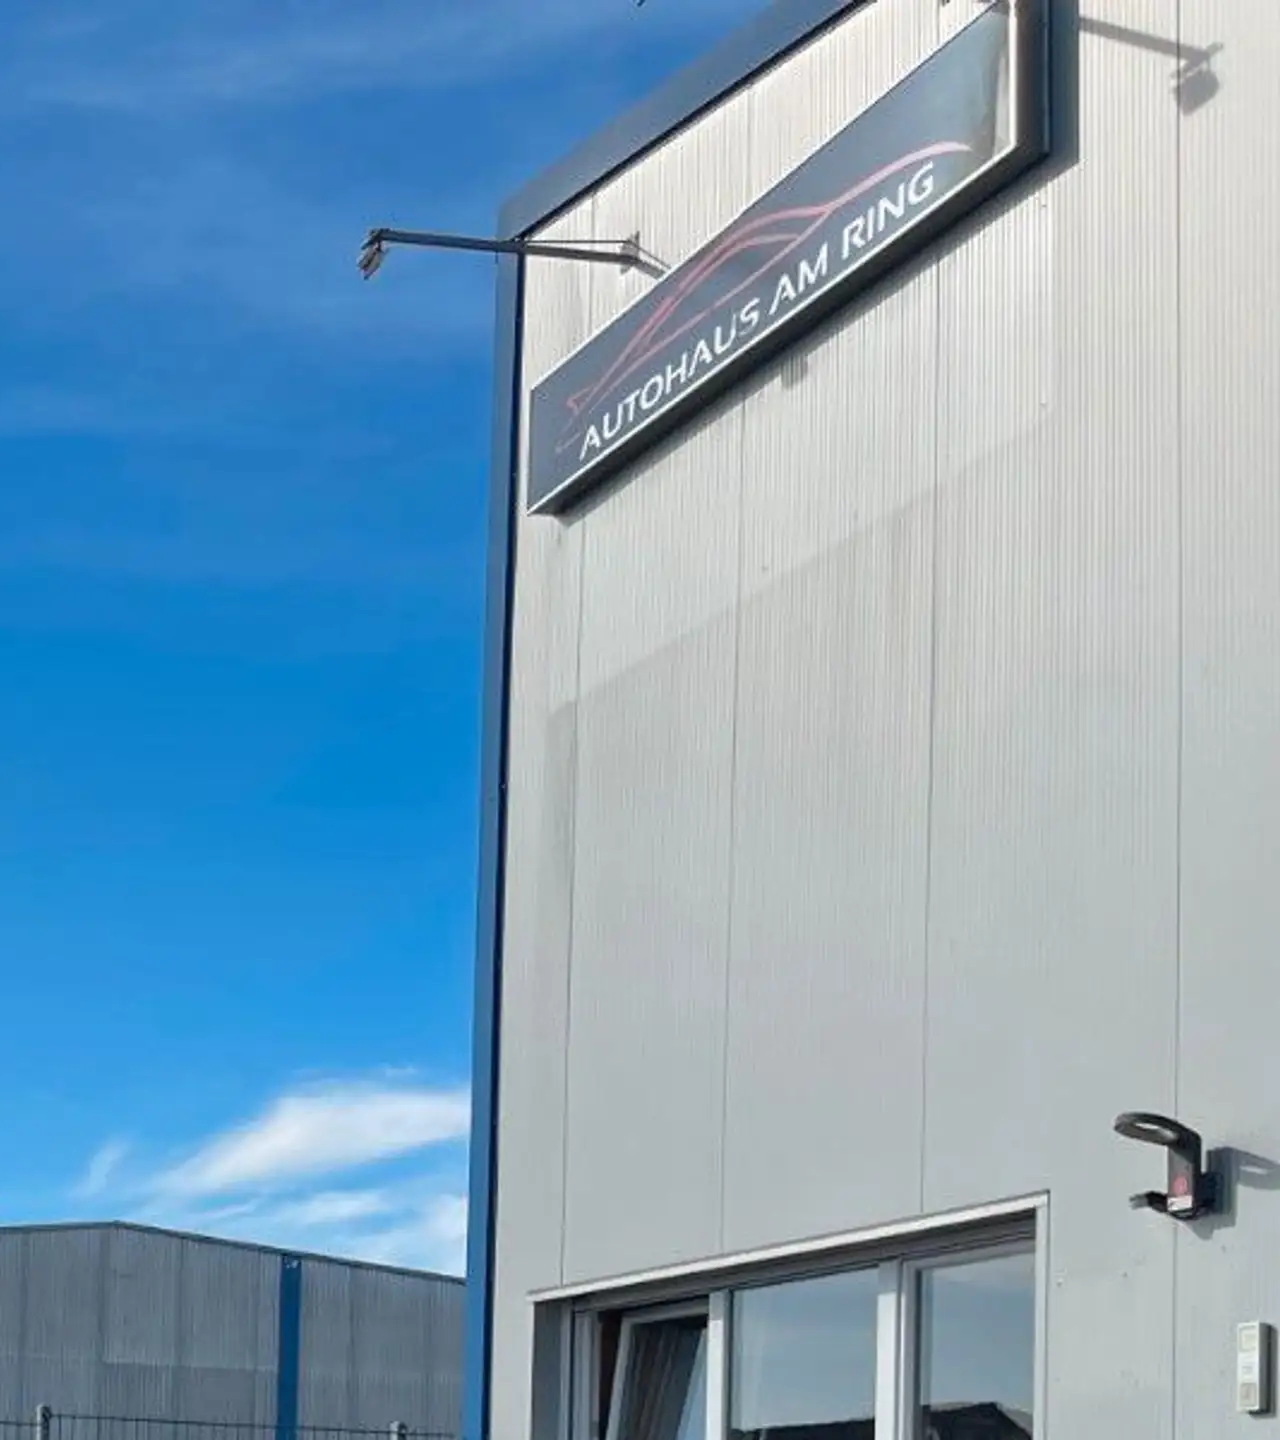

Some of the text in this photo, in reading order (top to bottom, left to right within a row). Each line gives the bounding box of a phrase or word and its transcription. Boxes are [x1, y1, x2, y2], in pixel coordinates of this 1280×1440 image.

[579, 161, 935, 462] AUTOHAUS AM RING
